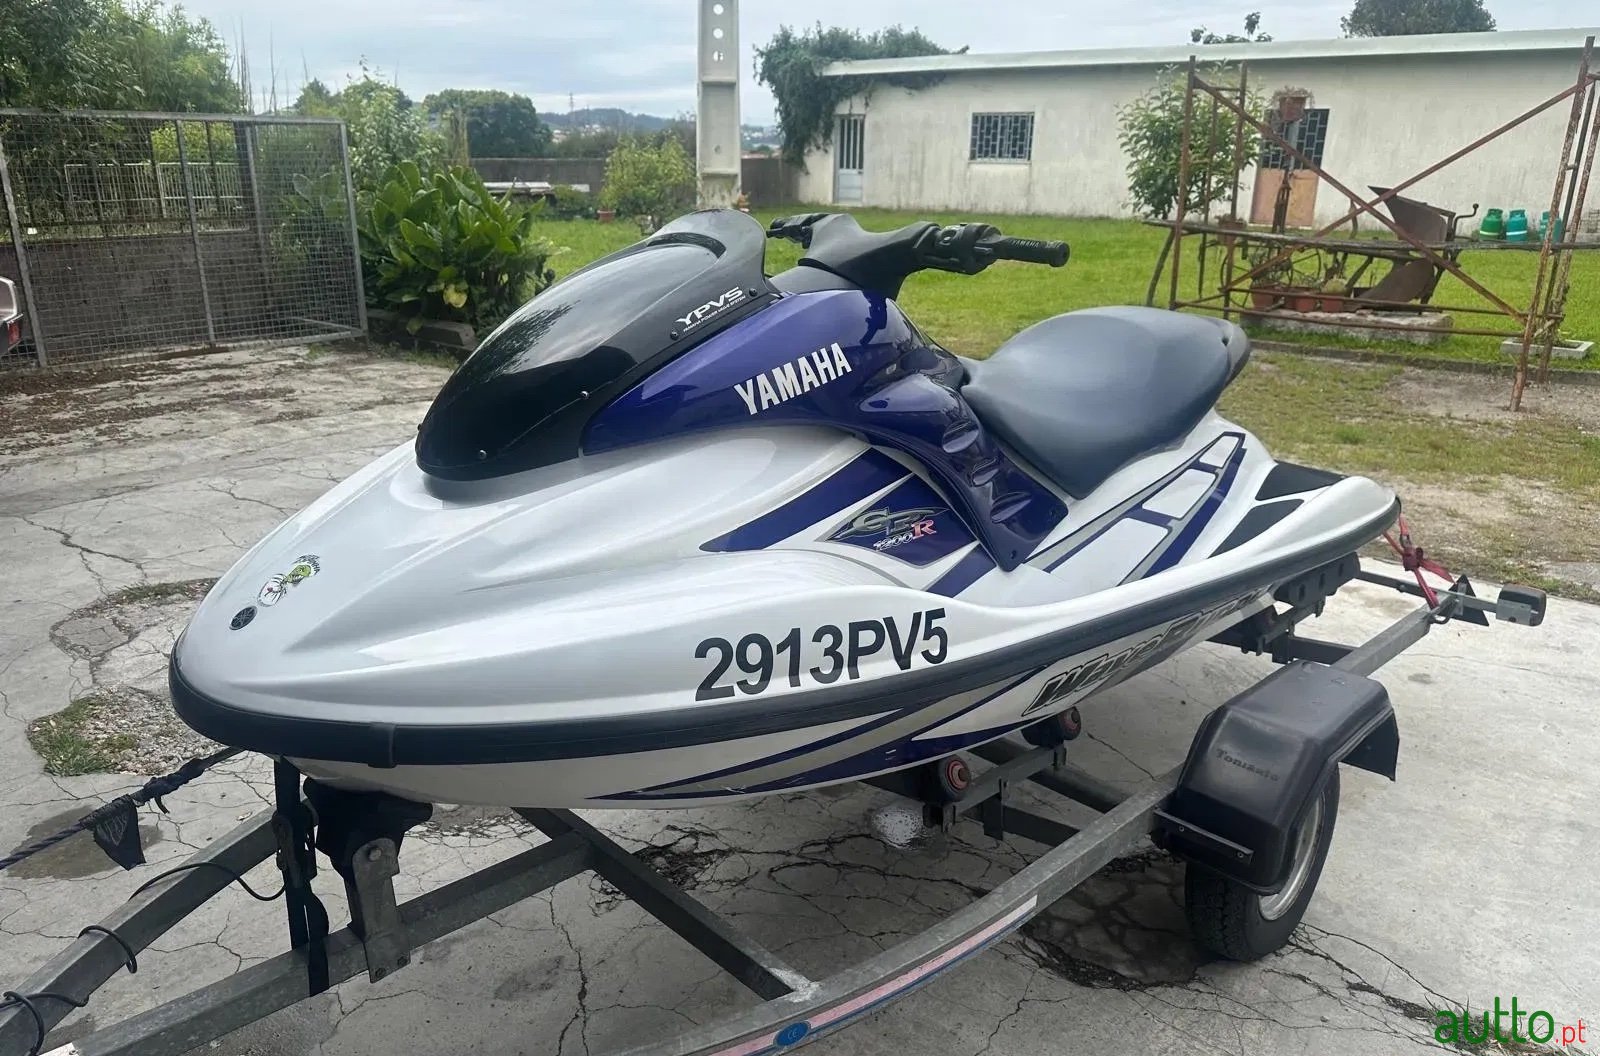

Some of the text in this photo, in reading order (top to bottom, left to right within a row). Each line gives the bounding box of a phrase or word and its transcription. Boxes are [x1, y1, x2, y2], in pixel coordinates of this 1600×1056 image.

[675, 286, 743, 326] YPVS
[734, 342, 852, 415] YAMAHA
[694, 608, 949, 702] 2913PV5
